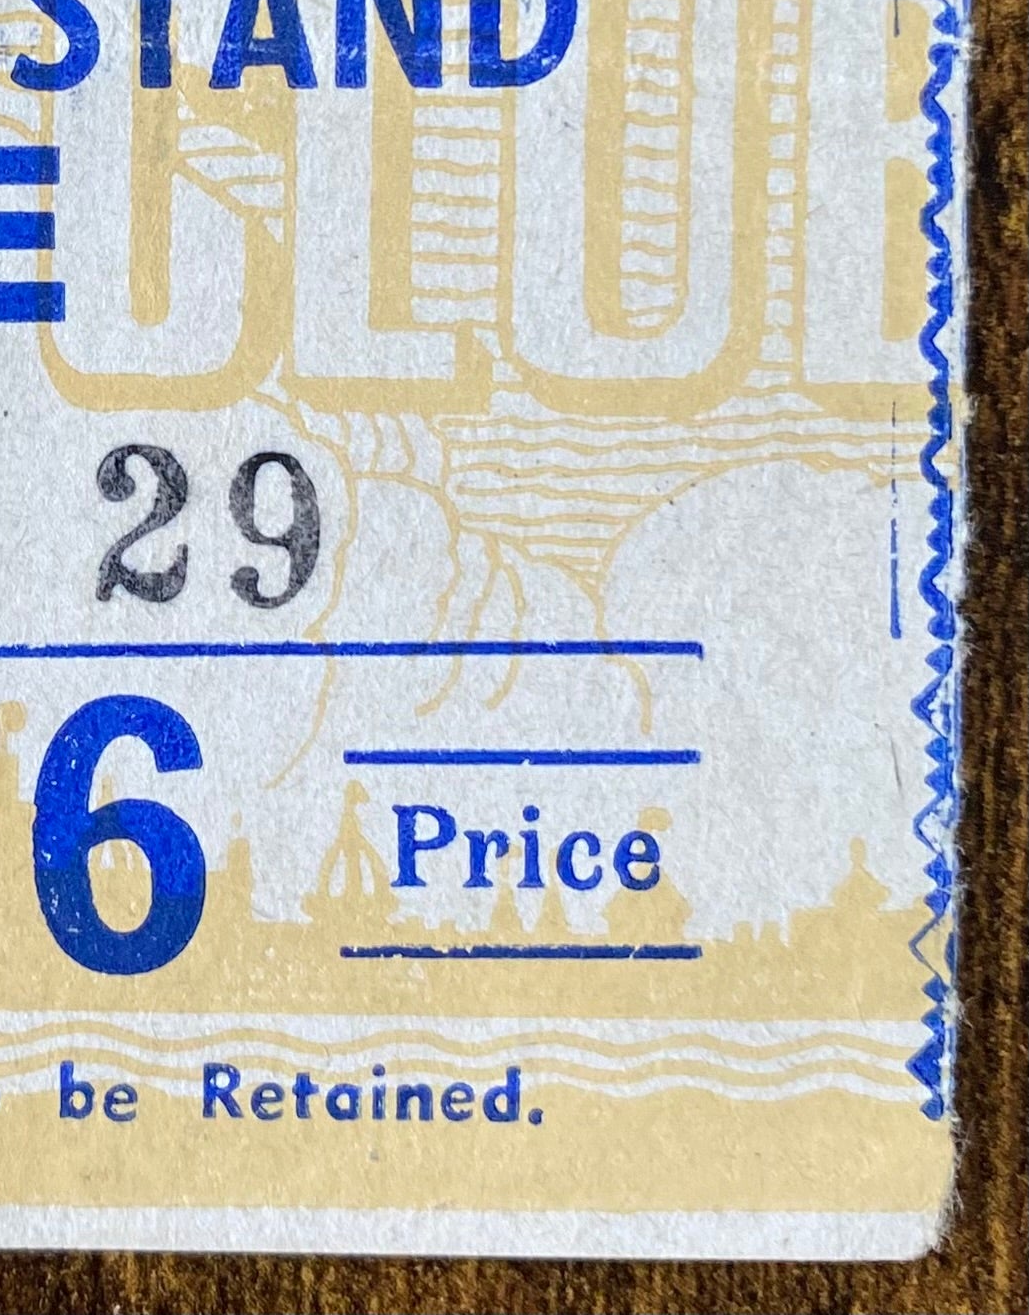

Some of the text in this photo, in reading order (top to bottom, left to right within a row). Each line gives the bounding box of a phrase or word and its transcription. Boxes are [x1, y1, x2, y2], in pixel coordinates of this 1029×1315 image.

[94, 442, 322, 610] 29
[390, 803, 662, 892] Price
[59, 1060, 139, 1122] be
[202, 1062, 544, 1125] Retained.
